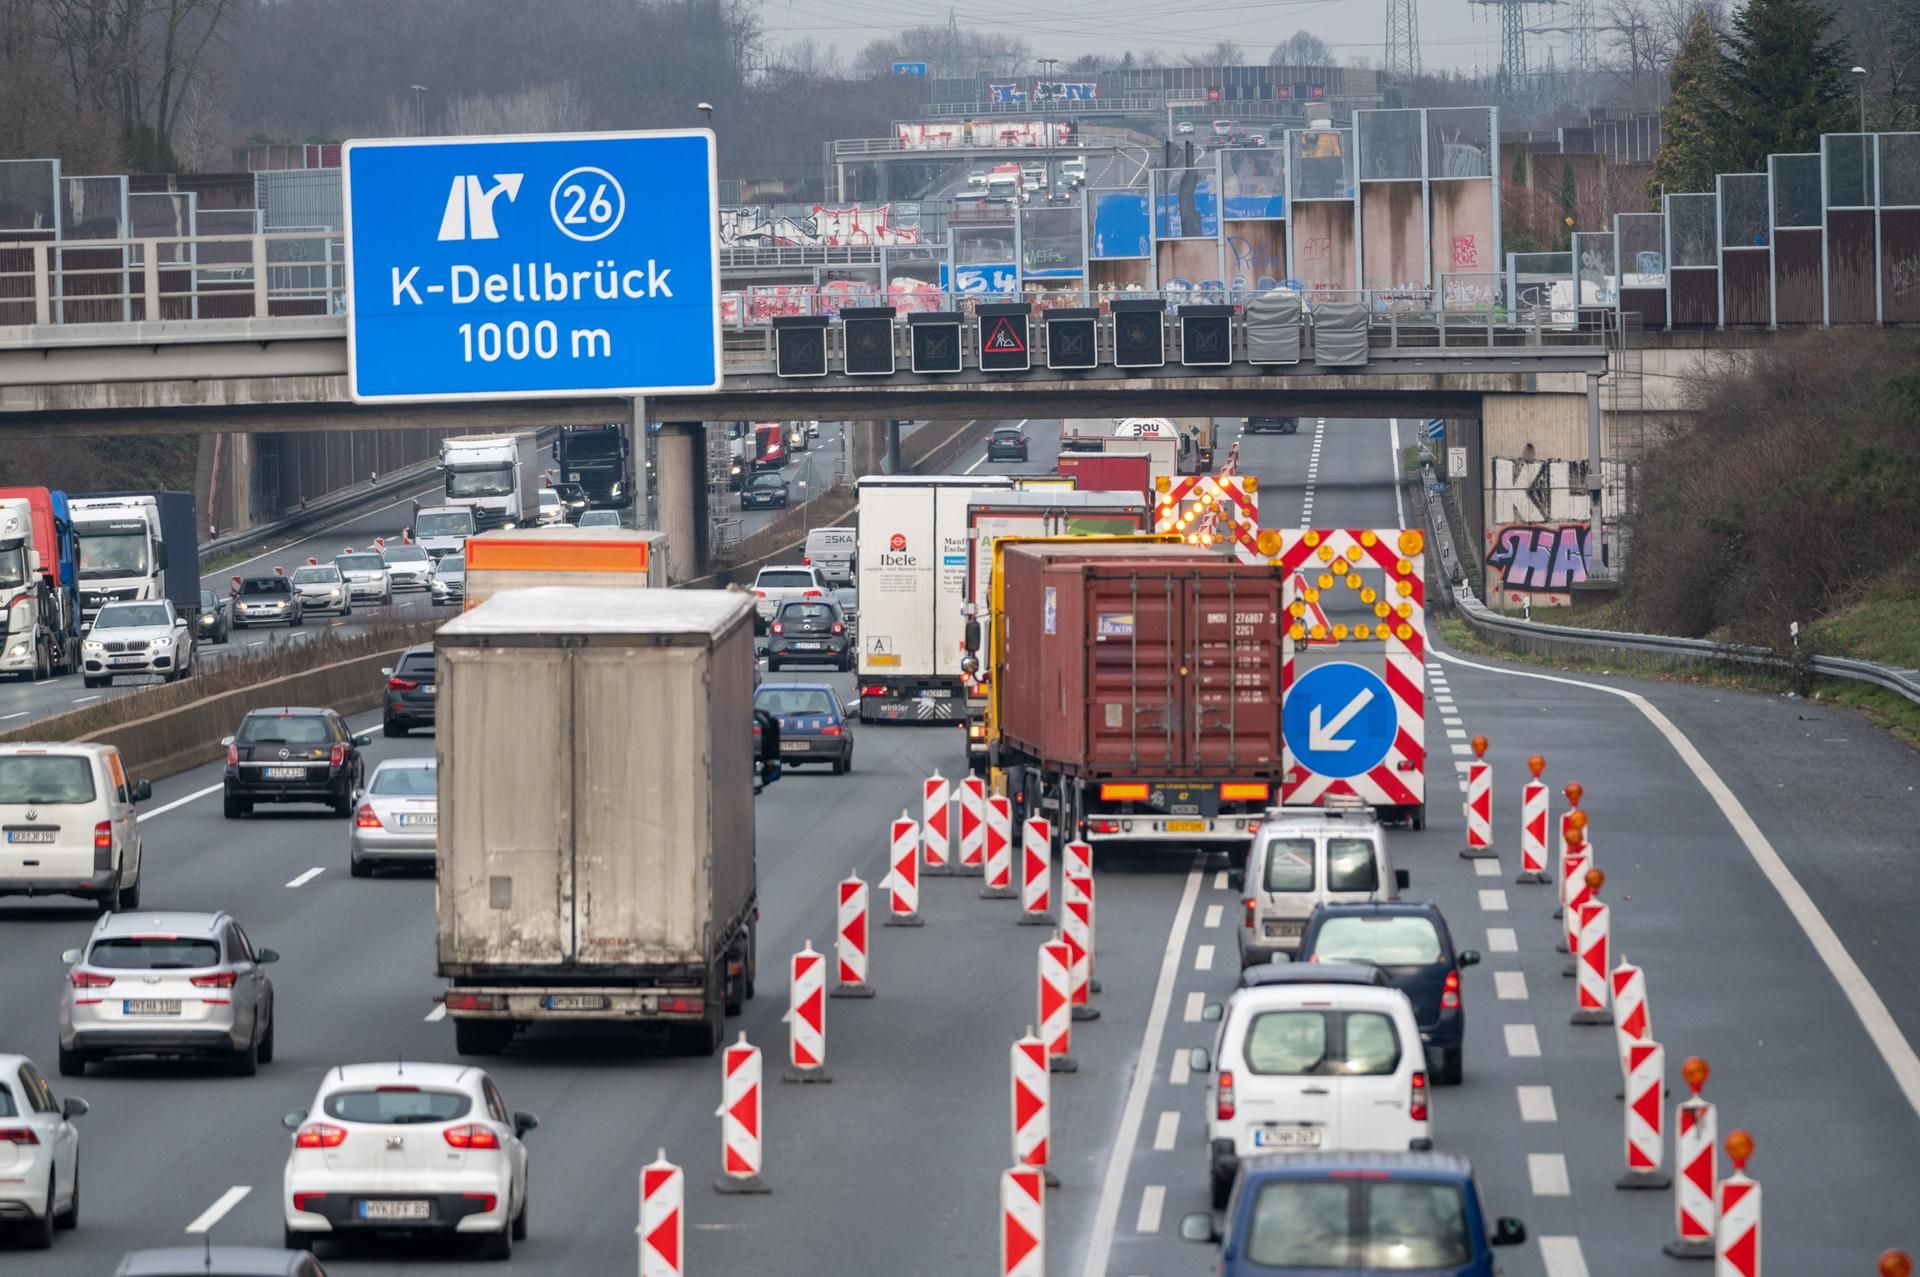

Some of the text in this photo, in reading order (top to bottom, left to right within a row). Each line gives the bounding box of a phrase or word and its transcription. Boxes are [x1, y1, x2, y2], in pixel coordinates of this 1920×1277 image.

[562, 183, 613, 225] 26
[391, 259, 673, 305] K-Dellbrück
[457, 320, 611, 363] 1000 m
[881, 553, 917, 566] Ibele
[874, 638, 884, 651] A
[880, 704, 908, 712] winkler
